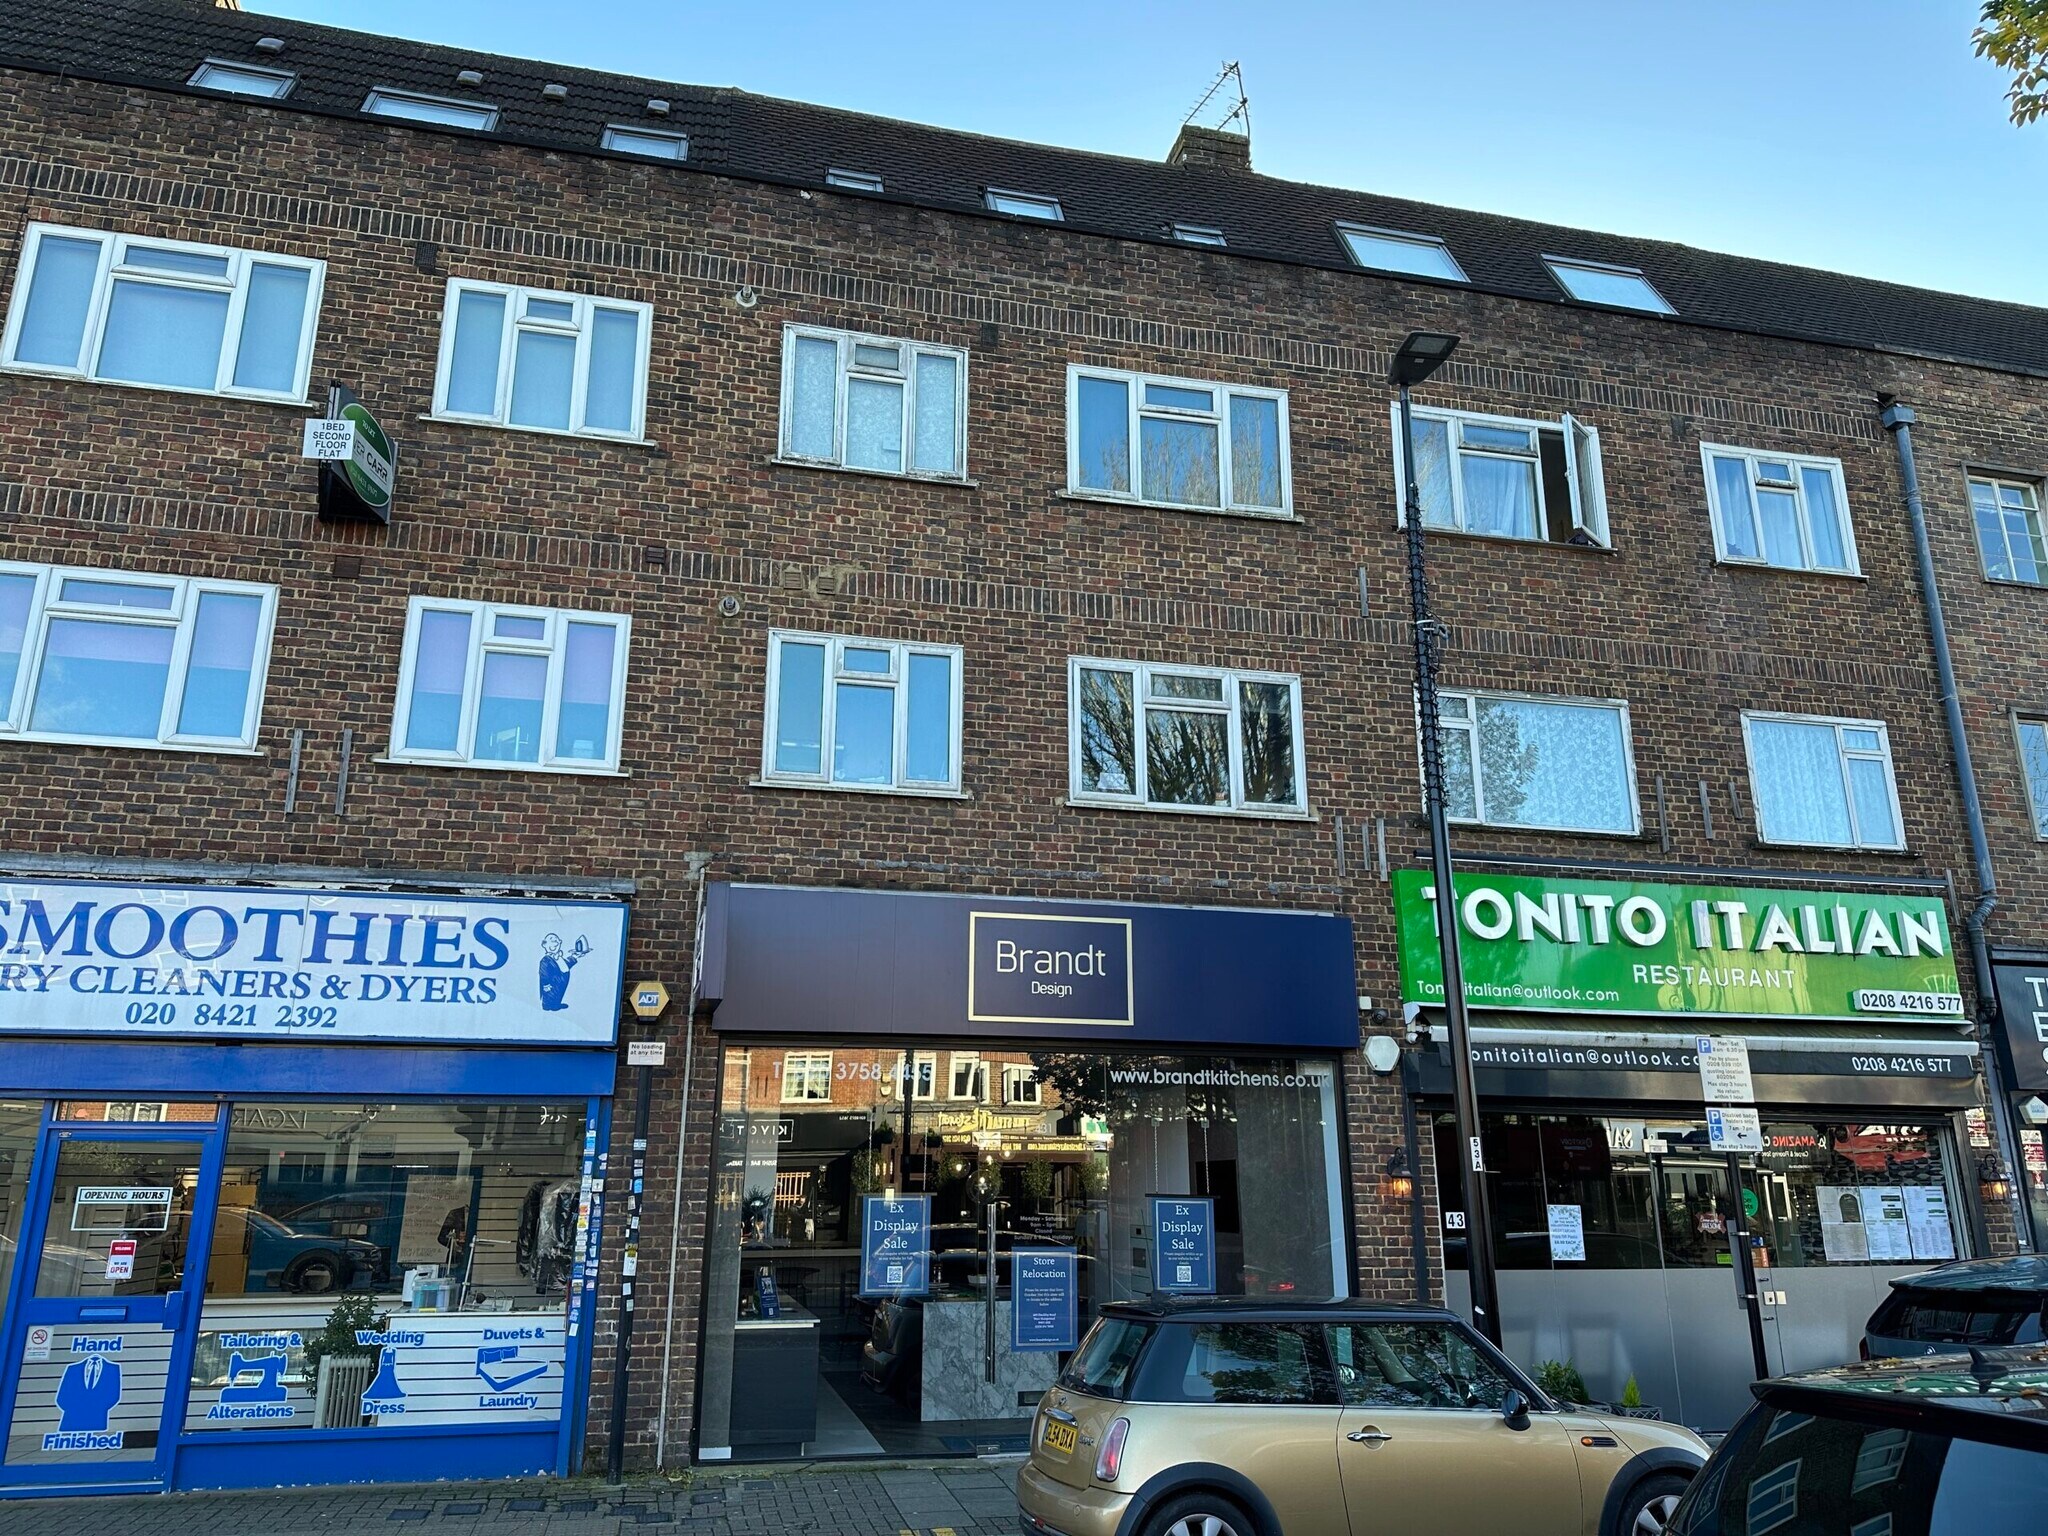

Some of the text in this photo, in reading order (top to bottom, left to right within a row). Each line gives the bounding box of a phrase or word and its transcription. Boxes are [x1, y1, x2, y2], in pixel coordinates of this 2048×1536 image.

[312, 431, 351, 441] SECOND
[315, 440, 347, 449] FLOOR
[318, 449, 342, 458] FLAT
[366, 452, 388, 481] CARR
[0, 899, 510, 970] MOOTHIES
[1691, 899, 1945, 958] ITALIAN
[996, 940, 1106, 976] Brandt
[69, 964, 312, 999] CLEANERS
[320, 974, 352, 1000] &
[357, 973, 497, 1004] DYERS
[1633, 964, 1795, 989] RESTAURANT
[1031, 981, 1072, 998] Design
[1417, 980, 1620, 1001] Tonitalian@outlook.com
[638, 994, 660, 1004] ADT
[1861, 993, 1961, 1011] 0208 4216 577
[125, 1001, 338, 1028] 020 8421 2392
[1701, 1040, 1709, 1052] P
[1471, 1047, 1700, 1067] onitoitalian@outlook.co
[1851, 1056, 1951, 1072] 0208 4216 577
[835, 1063, 882, 1081] 3758
[1110, 1069, 1331, 1089] www.brandtkitchens.co.uk
[1711, 1111, 1719, 1123] P
[1472, 1138, 1482, 1170] 53A
[84, 1191, 164, 1200] OPENING HOURS
[889, 1202, 904, 1213] Ex
[1175, 1205, 1189, 1215] Ex
[874, 1219, 919, 1234] Display
[1447, 1213, 1464, 1227] 43
[1162, 1221, 1204, 1235] Display
[883, 1237, 908, 1249] Sale
[1171, 1238, 1195, 1250] Sale
[1033, 1257, 1055, 1265] Store
[1022, 1269, 1066, 1278] Relocation
[221, 1333, 303, 1349] Tailoring &
[356, 1331, 424, 1346] Wedding
[483, 1327, 545, 1340] Duvets &
[72, 1337, 122, 1352] Hand
[362, 1402, 405, 1414] Dress
[479, 1394, 538, 1409] Laundry
[207, 1405, 294, 1419] Alterations
[43, 1432, 122, 1449] Finished
